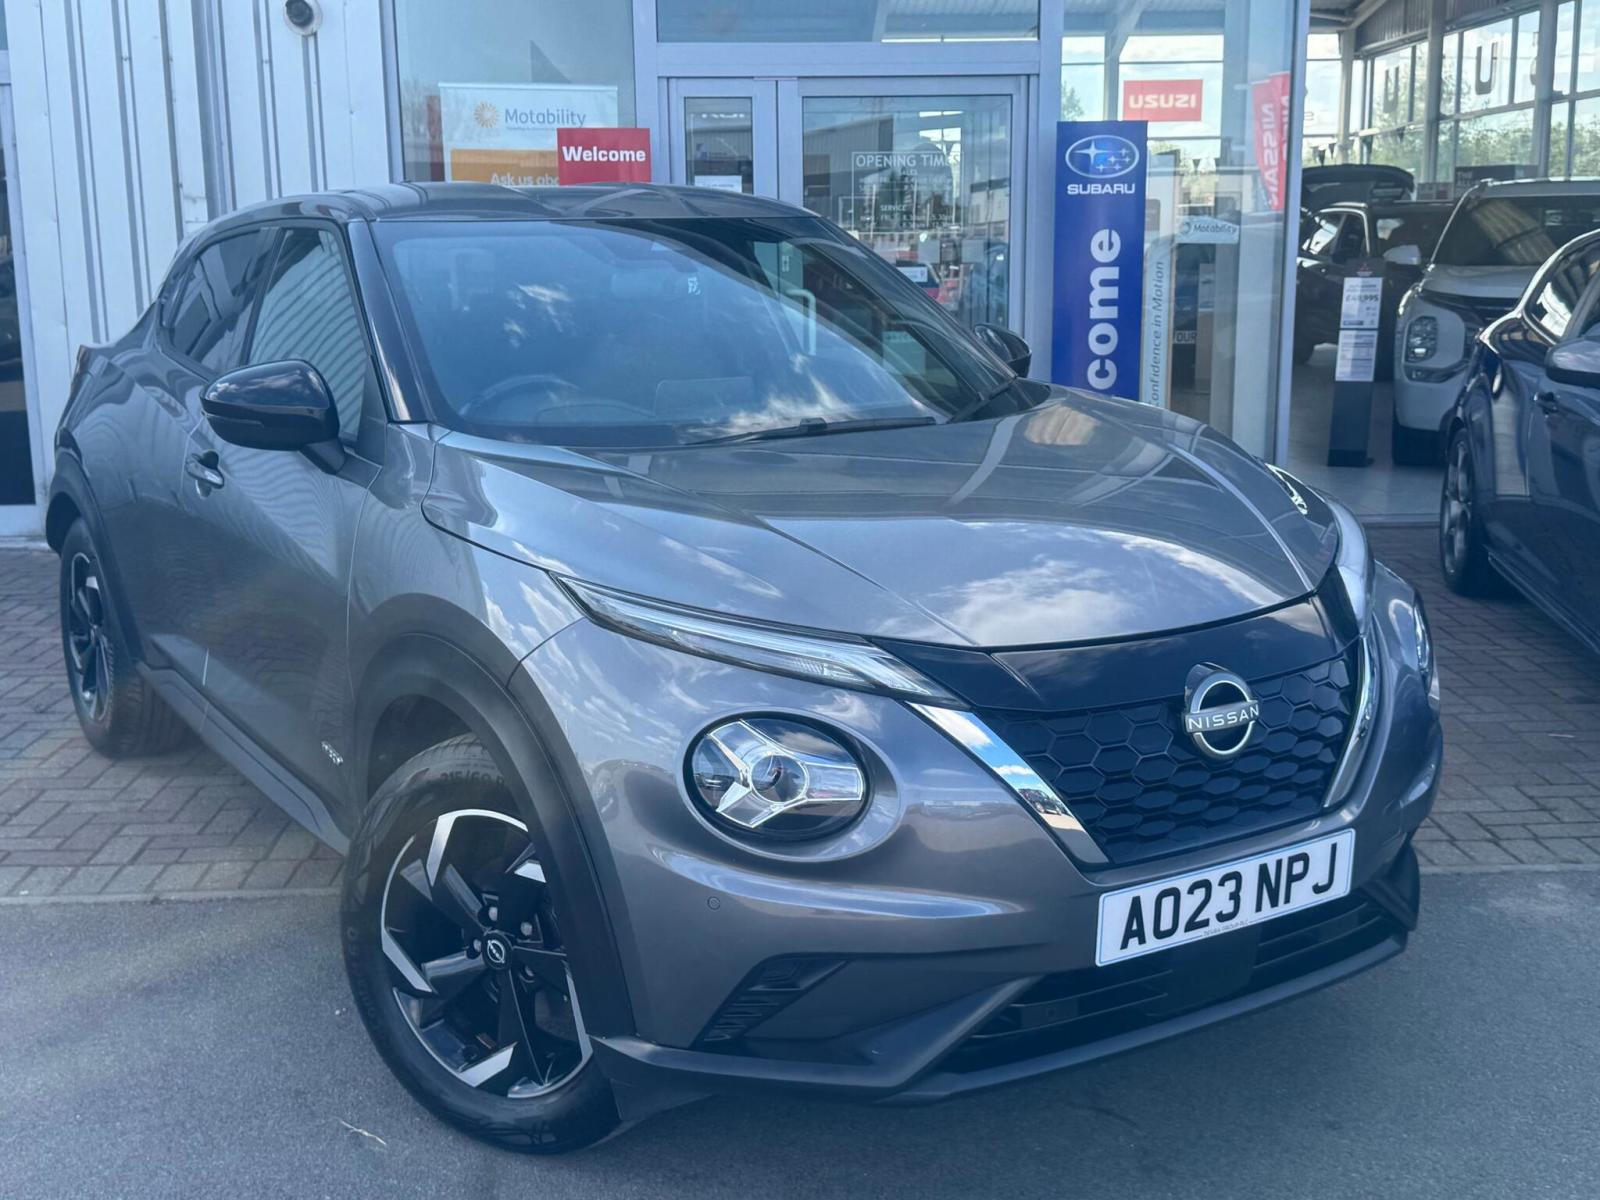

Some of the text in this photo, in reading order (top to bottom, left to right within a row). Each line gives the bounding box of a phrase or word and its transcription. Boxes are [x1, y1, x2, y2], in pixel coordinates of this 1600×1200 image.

[505, 108, 587, 126] Motability
[562, 146, 646, 162] Welcome
[856, 154, 916, 167] OPENING
[490, 172, 514, 185] Ask
[518, 175, 534, 185] us
[1067, 183, 1136, 195] SUBARU
[1152, 261, 1165, 311] Motion
[1188, 704, 1260, 730] NISSAN
[1255, 842, 1338, 913] NPJ
